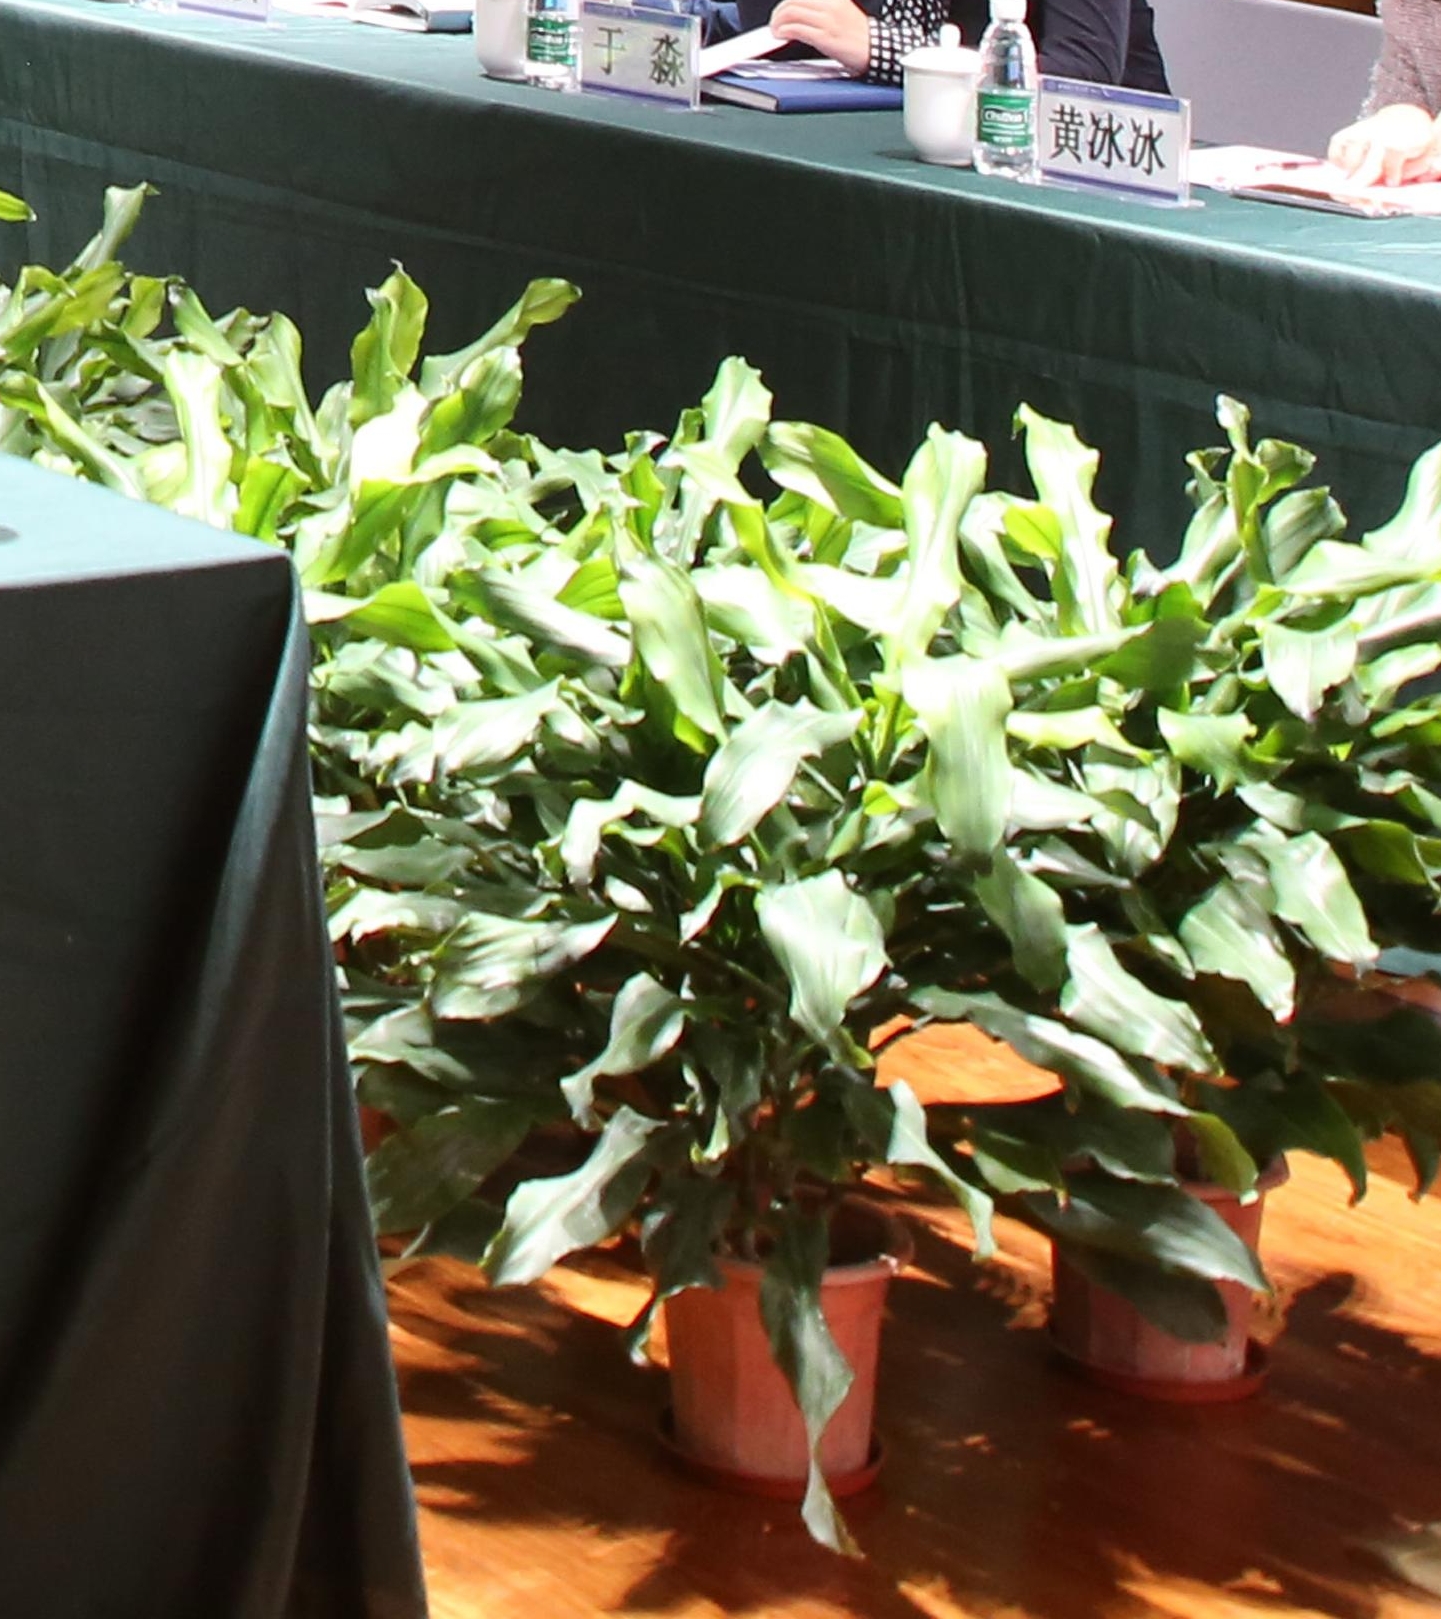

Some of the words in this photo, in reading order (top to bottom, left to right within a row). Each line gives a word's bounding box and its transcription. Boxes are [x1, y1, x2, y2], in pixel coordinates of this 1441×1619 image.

[593, 26, 685, 88] 于淼
[1048, 103, 1165, 175] 黄冰冰
